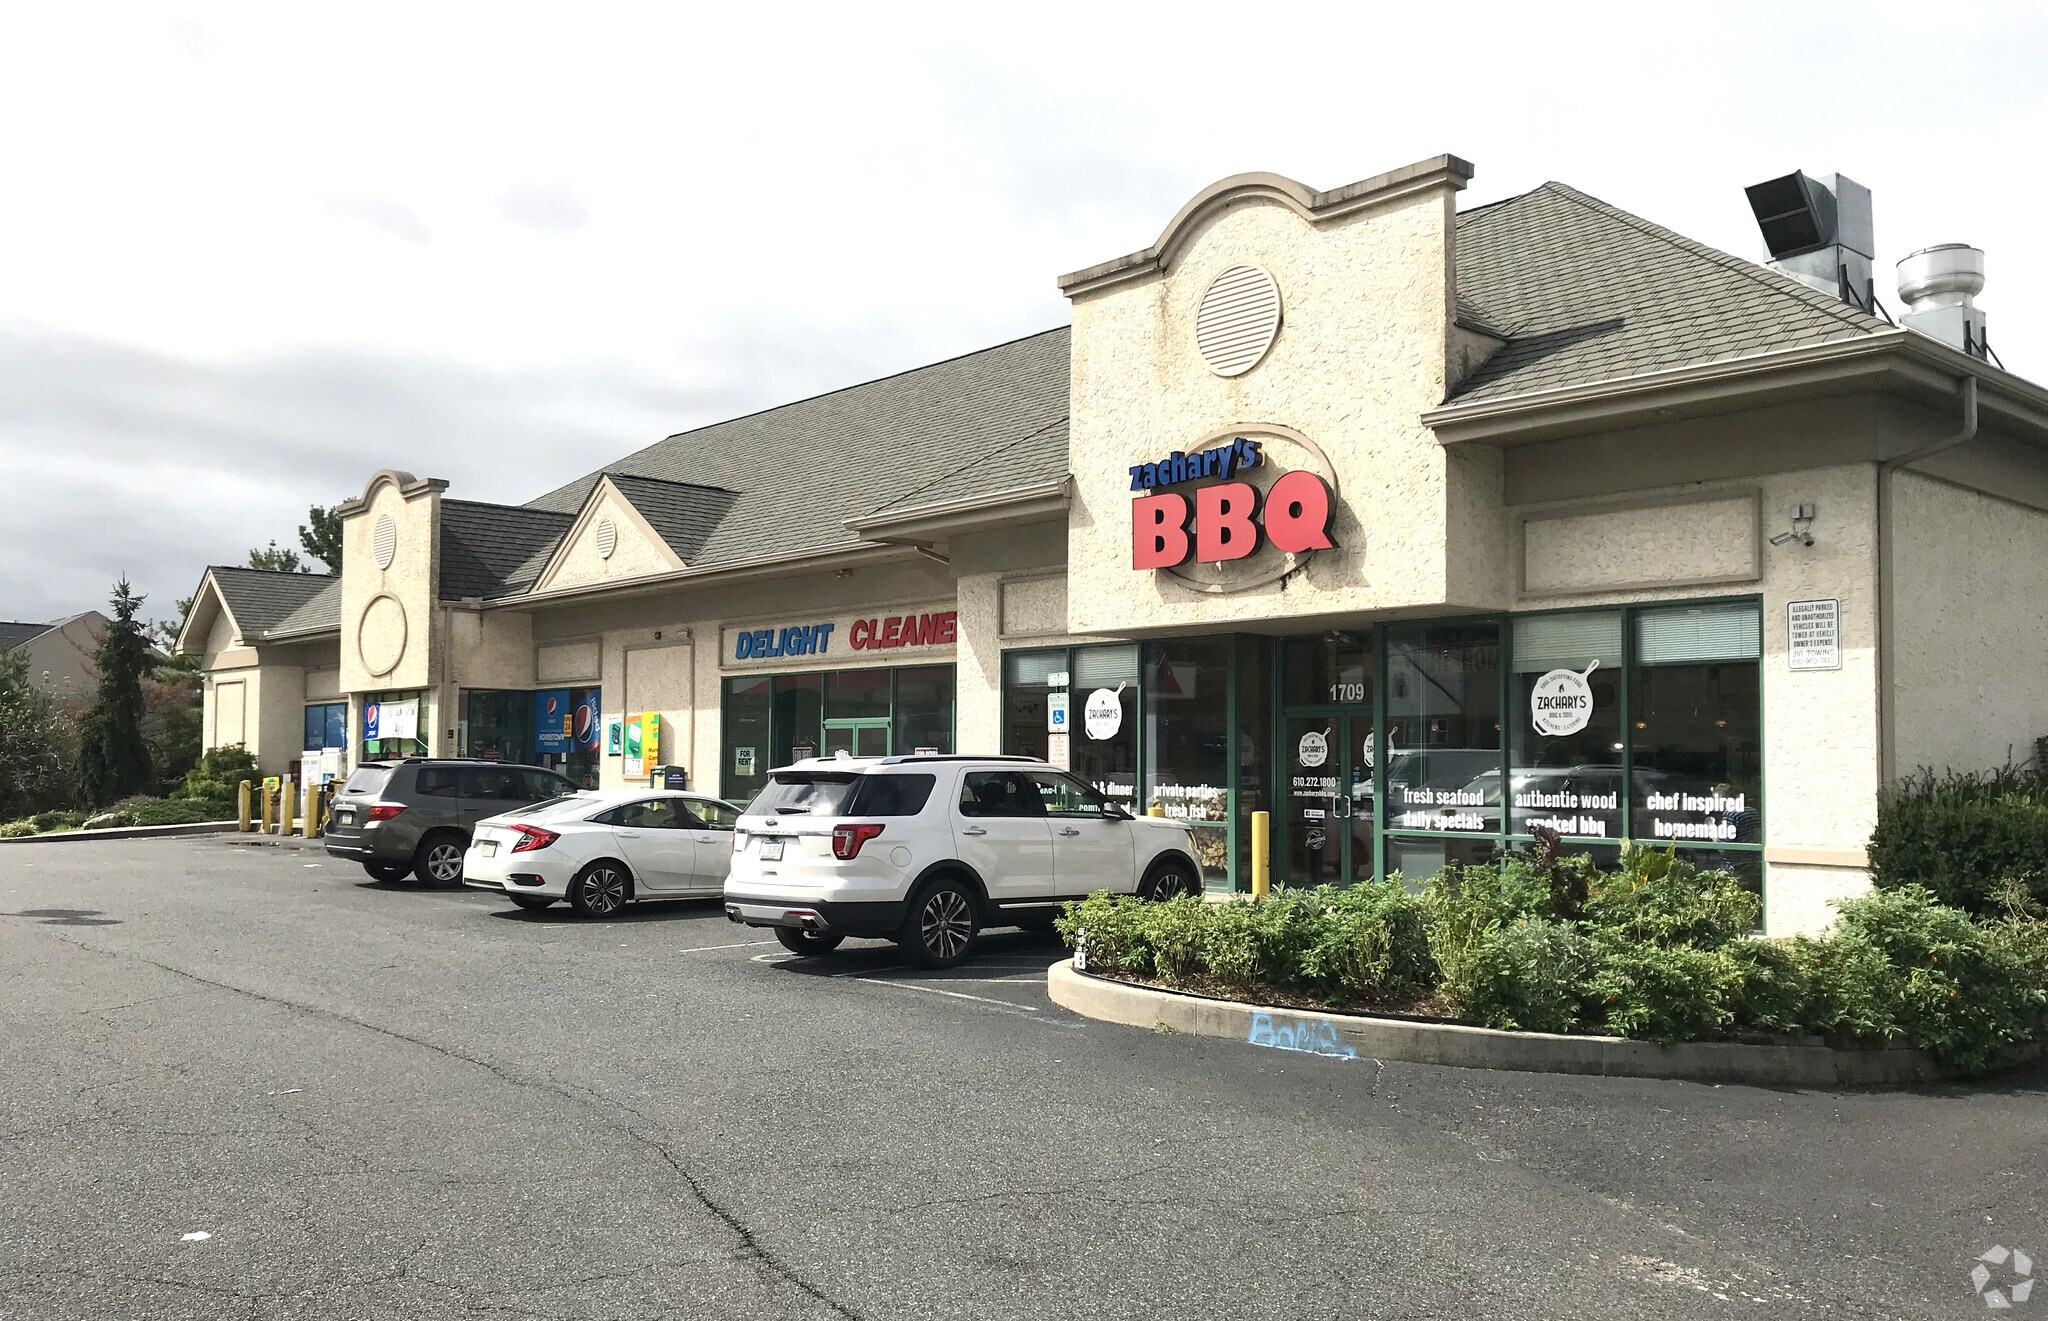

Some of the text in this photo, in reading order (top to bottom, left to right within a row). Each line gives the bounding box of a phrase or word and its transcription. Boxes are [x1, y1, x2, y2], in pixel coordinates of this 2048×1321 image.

[1129, 437, 1263, 491] zachary's
[1132, 470, 1337, 570] BBQ
[1792, 604, 1814, 612] ILLEGALLY
[1802, 612, 1834, 620] UNAUTHORIZED
[1793, 622, 1814, 630] VEHICLES
[735, 611, 957, 659] DELIGHT CLEANE
[1792, 631, 1807, 639] TOWED
[1330, 683, 1365, 700] 1709
[1100, 781, 1105, 795] &
[1107, 782, 1134, 796] dinner
[1293, 777, 1336, 788] 610.272.1800
[1154, 783, 1219, 800] private parties
[1404, 788, 1484, 806] fresh seafood
[1515, 790, 1617, 810] authentic wood
[1165, 803, 1206, 819] fresh fish
[1647, 791, 1745, 814] chef inspired
[1404, 810, 1484, 831] daily specials
[1525, 815, 1606, 837] smoked bbq
[1654, 817, 1737, 839] homemade
